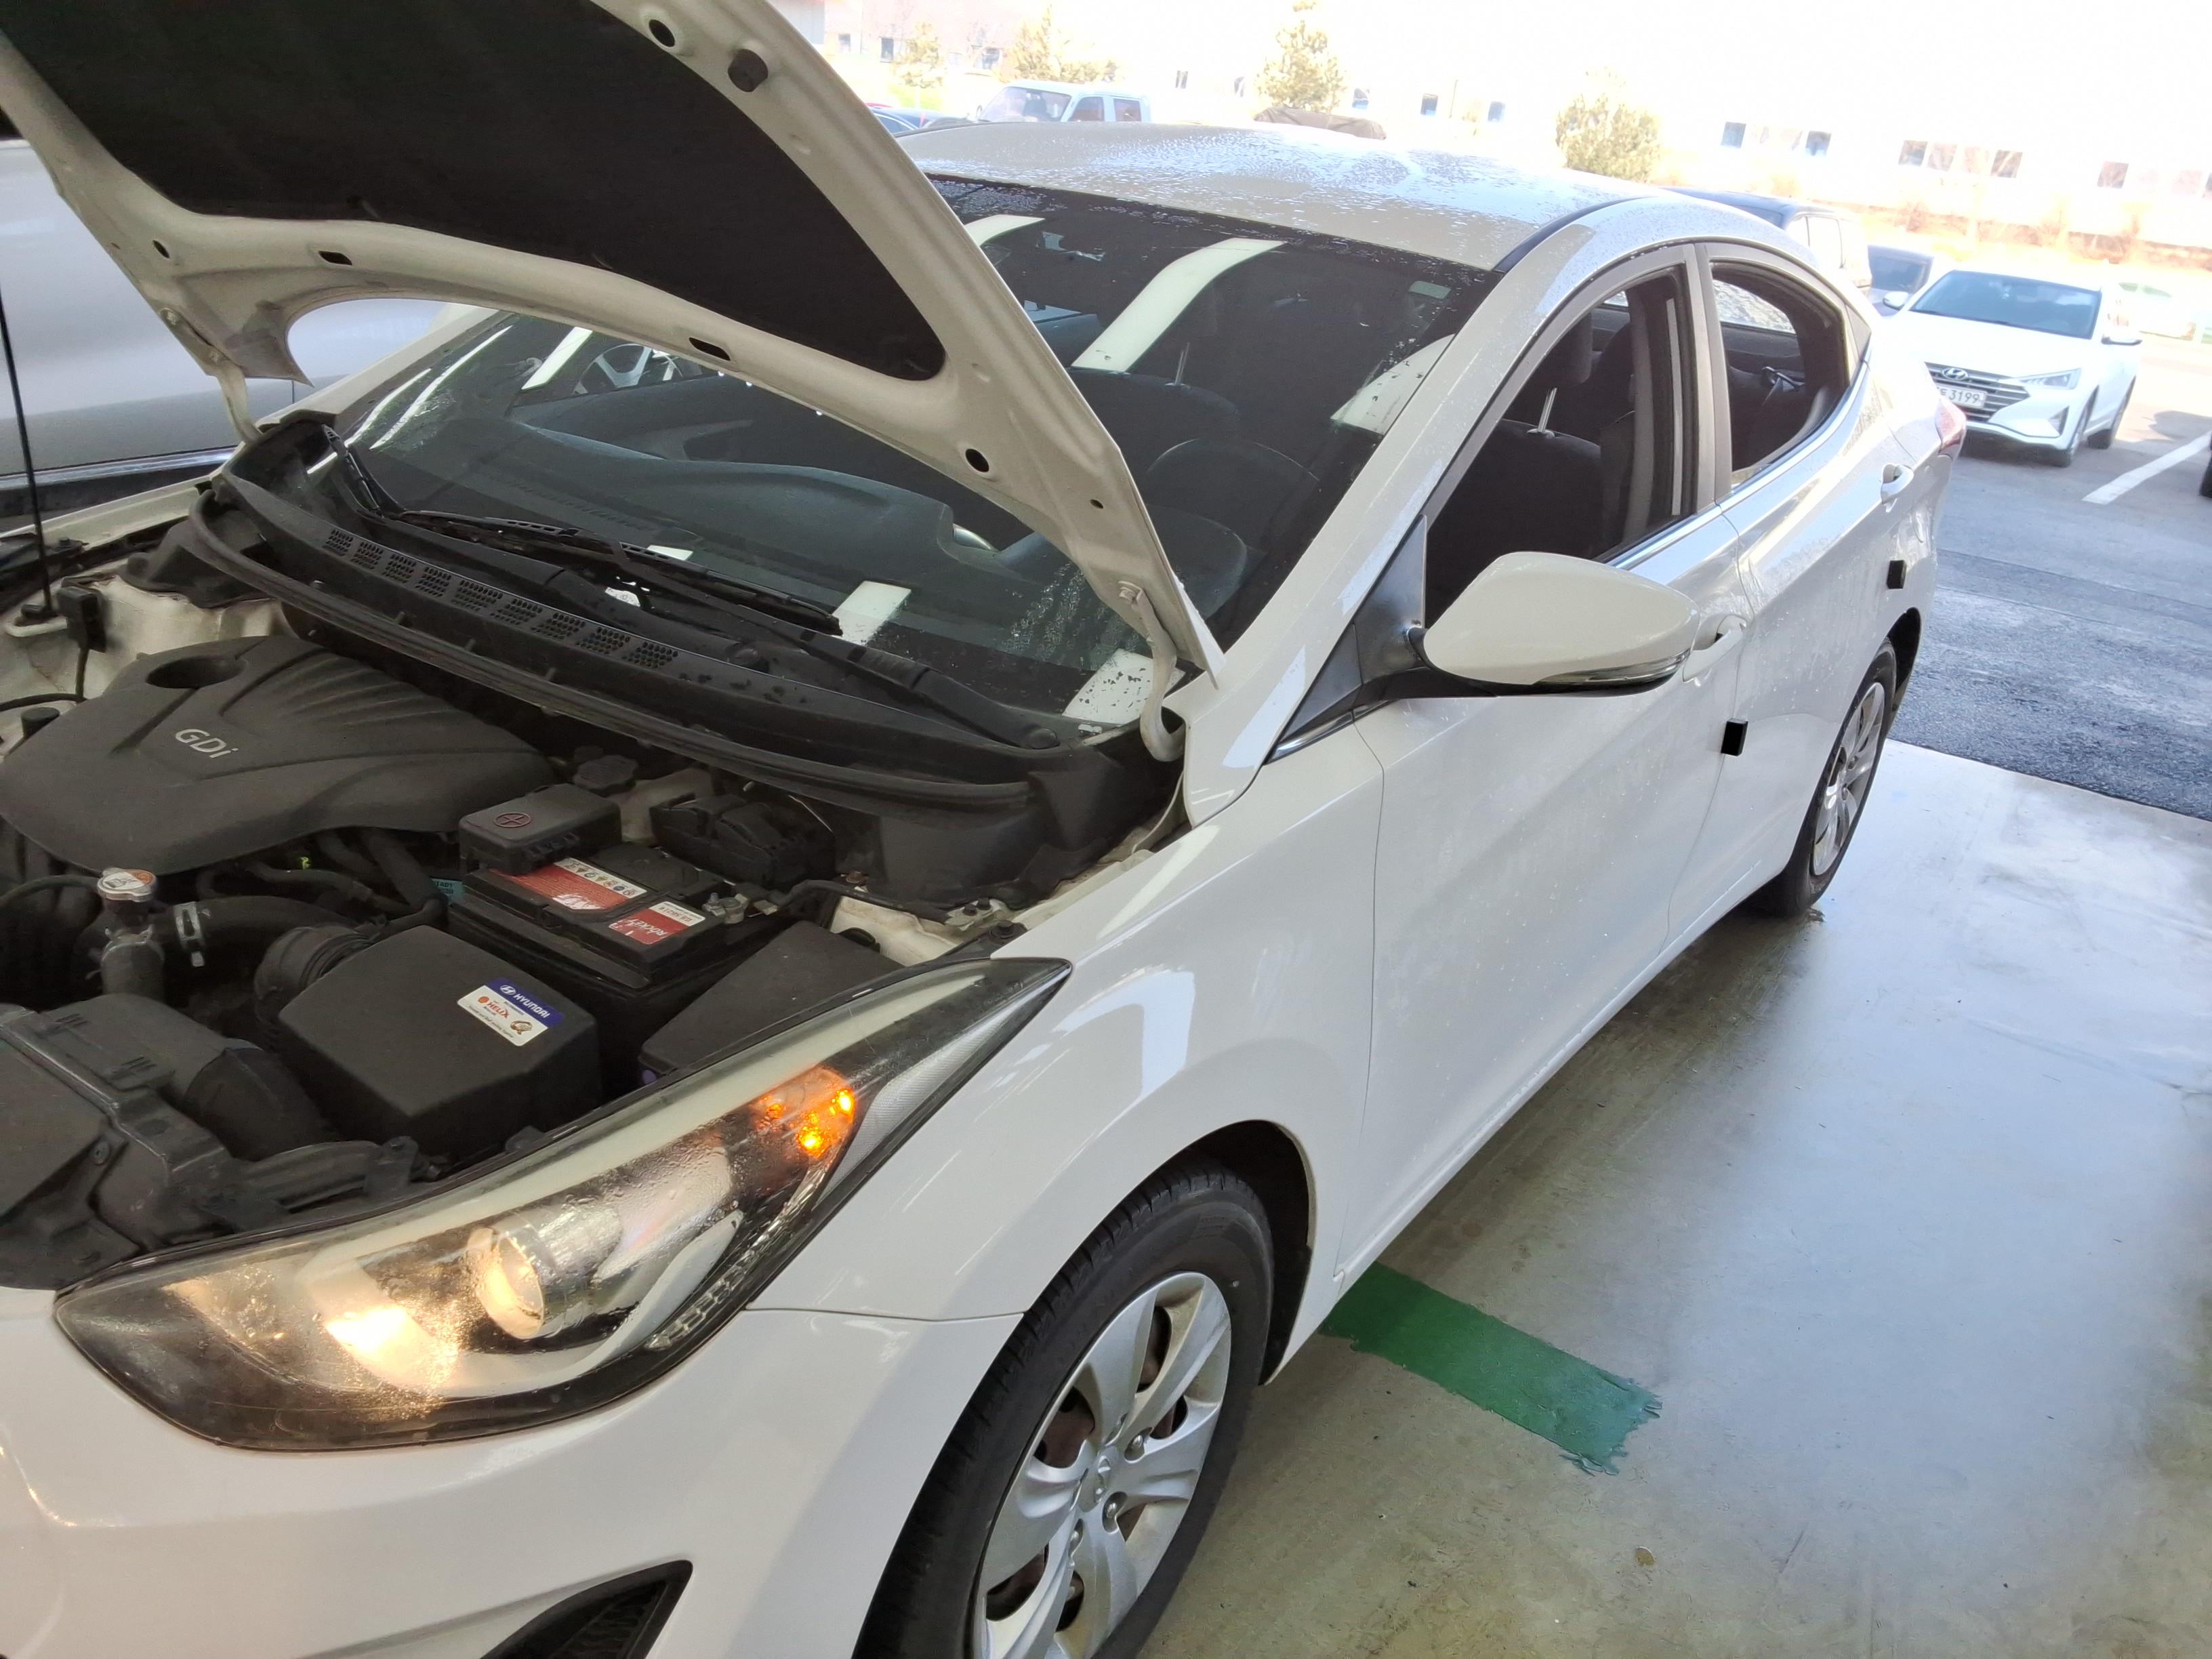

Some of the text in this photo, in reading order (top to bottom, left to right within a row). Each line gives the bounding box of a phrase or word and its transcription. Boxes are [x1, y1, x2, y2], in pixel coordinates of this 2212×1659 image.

[176, 729, 239, 758] GDi
[487, 1002, 510, 1019] HELIX
[513, 994, 551, 1019] HYUNDAI
